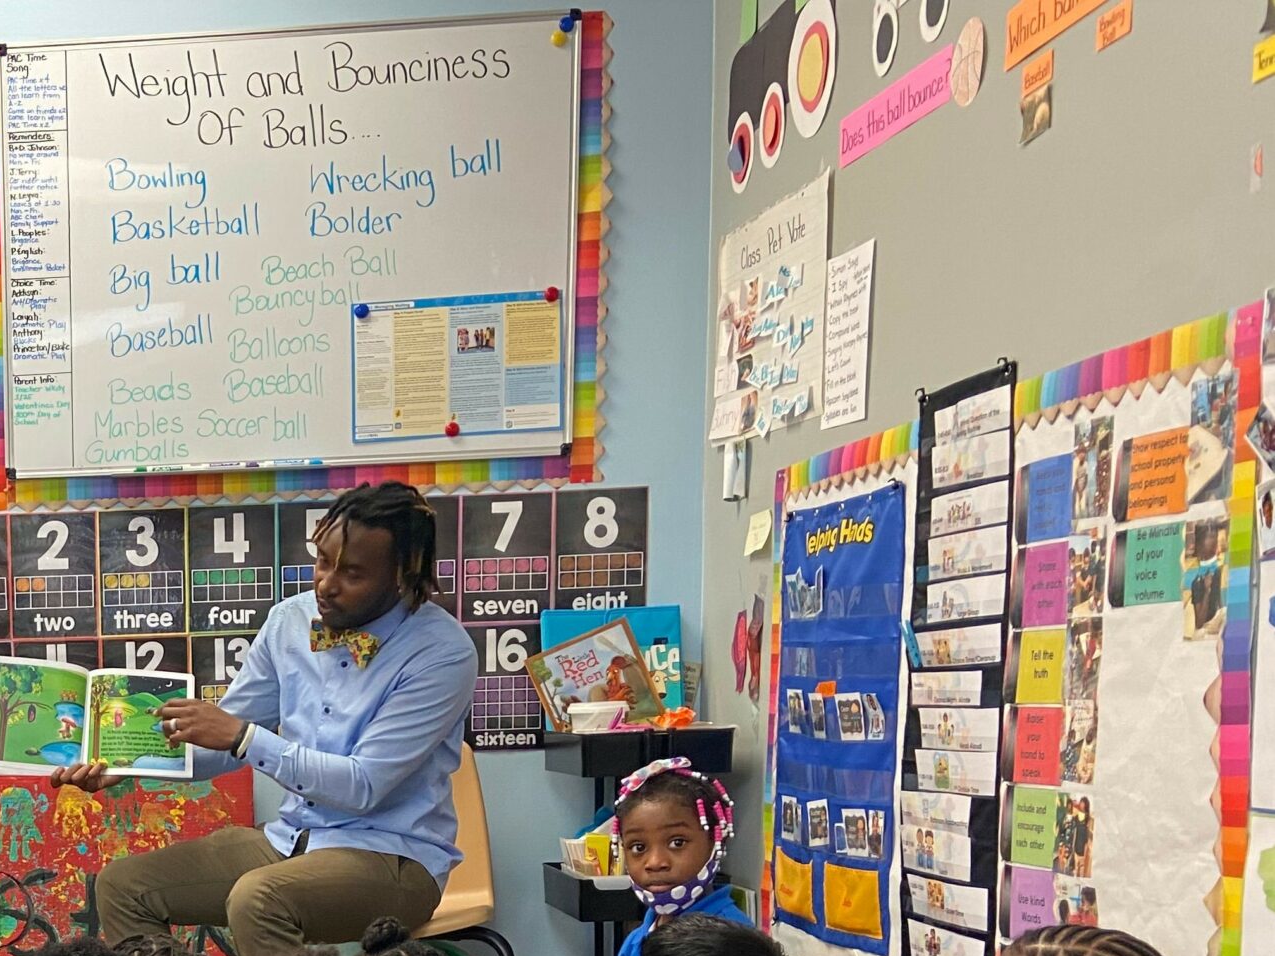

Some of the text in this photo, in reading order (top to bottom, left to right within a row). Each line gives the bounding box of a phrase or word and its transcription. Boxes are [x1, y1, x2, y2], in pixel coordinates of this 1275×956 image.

[25, 53, 48, 63] Time
[99, 42, 511, 125] Weight and Bounciness
[197, 107, 245, 146] Of
[841, 127, 864, 155] Does
[867, 110, 885, 138] this
[887, 89, 905, 125] ball
[104, 157, 208, 209] Bowling
[309, 139, 502, 208] Wrecking ball
[111, 201, 261, 245] Basketball
[305, 202, 402, 237] Bolder
[741, 212, 806, 270] Class Pet Vote
[109, 251, 220, 312] Big ball
[261, 246, 398, 286] Beach Ball
[106, 314, 213, 358] Baseball
[227, 328, 330, 363] Balloons
[108, 371, 192, 405] Beads
[223, 363, 324, 404] Baseball
[94, 407, 308, 441] Marbles Soccer ball
[84, 440, 189, 464] Gumballs
[1150, 435, 1178, 450] respect
[1144, 472, 1177, 489] personal
[213, 512, 250, 563] 4
[490, 500, 523, 553] 7
[583, 496, 619, 548] 8
[36, 520, 70, 571] 2
[125, 516, 160, 567] 3
[806, 526, 839, 557] elping
[1136, 548, 1164, 562] of your
[1135, 568, 1158, 581] voice
[473, 598, 539, 616] seven
[572, 591, 629, 610] eight
[1134, 588, 1165, 601] volume
[34, 613, 75, 633] two
[113, 607, 174, 630] three
[208, 606, 257, 626] four
[484, 628, 528, 673] 16
[554, 653, 570, 664] The
[559, 650, 600, 679] Red
[1030, 650, 1054, 661] Tell the
[571, 670, 605, 690] Hen
[1033, 668, 1049, 680] truth
[475, 732, 537, 747] sixteen
[1030, 895, 1045, 907] kind
